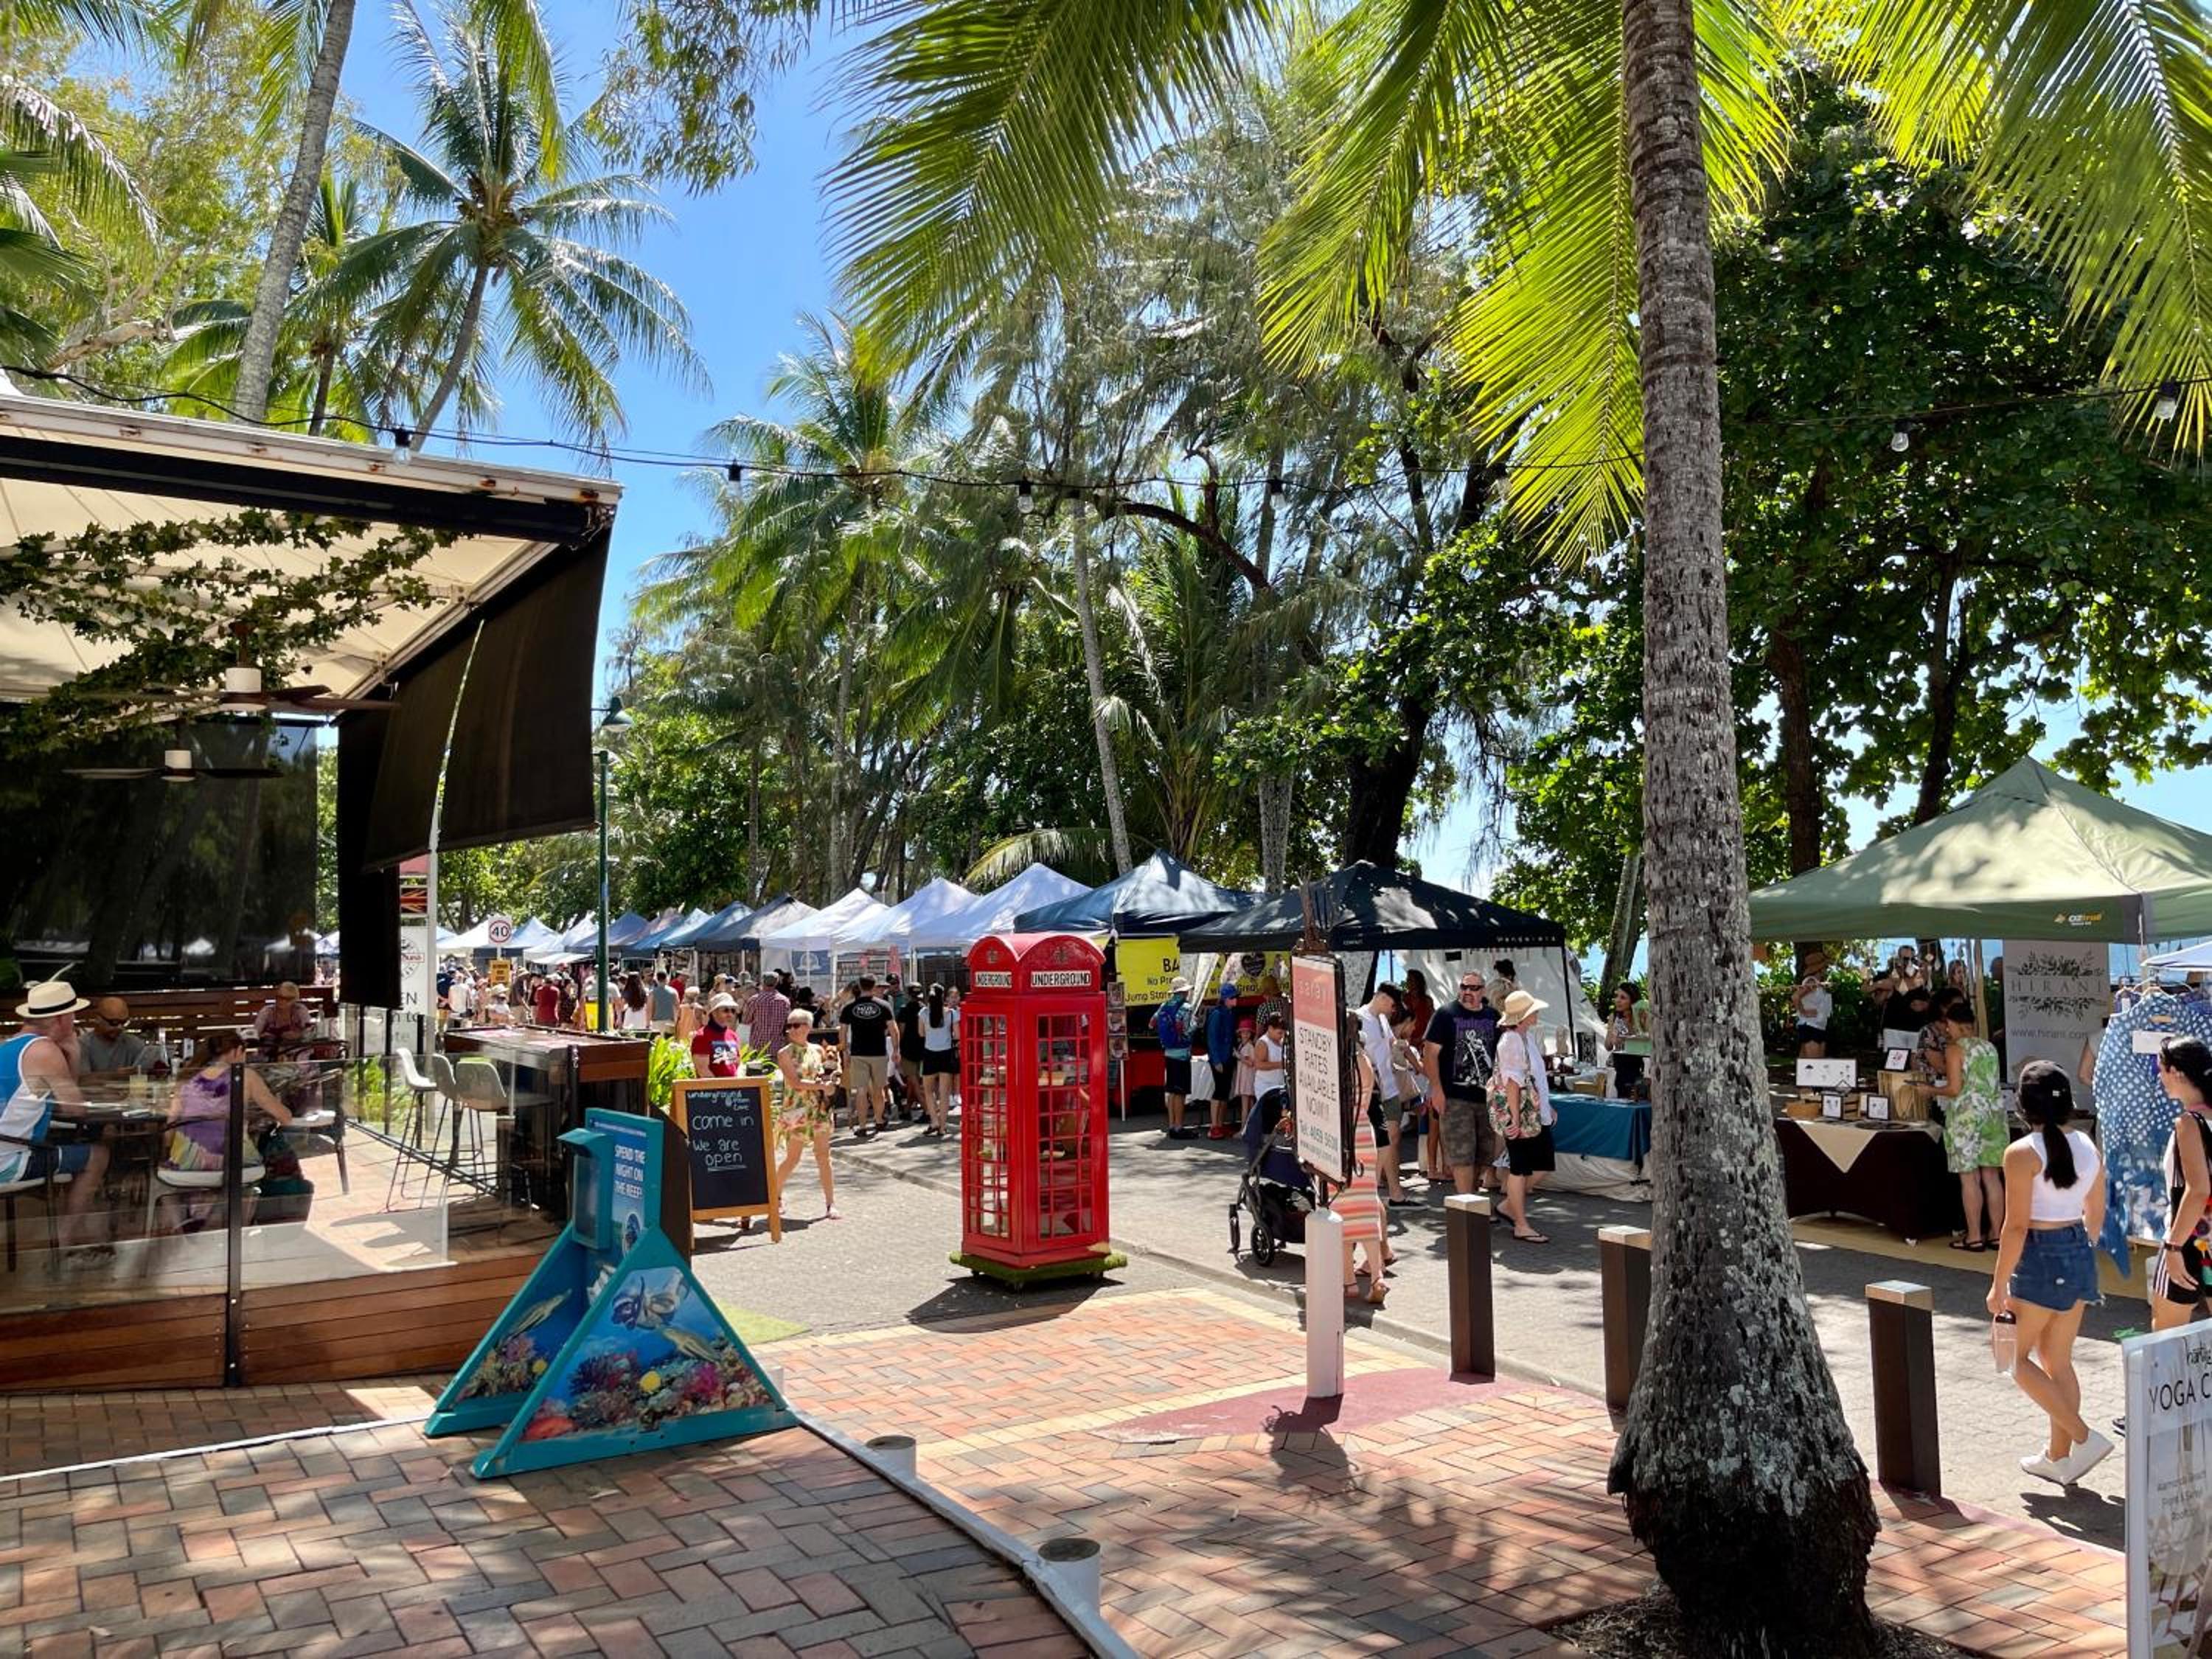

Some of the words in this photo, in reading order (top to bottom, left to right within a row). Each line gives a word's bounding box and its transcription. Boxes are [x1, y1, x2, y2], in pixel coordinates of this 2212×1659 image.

[492, 926, 509, 937] 40
[1032, 973, 1091, 987] UNDERGROUND
[2011, 979, 2101, 992] HIRANI
[1298, 1026, 1332, 1053] STANDBY
[1304, 1051, 1328, 1076] RATES
[1298, 1071, 1337, 1102] AVAILABLE
[740, 1116, 754, 1127] in
[717, 1138, 740, 1151] are
[615, 1144, 633, 1161] SPEND
[634, 1149, 646, 1165] THE
[705, 1152, 742, 1167] open
[615, 1163, 633, 1178] NIGHT
[633, 1167, 644, 1182] ON
[614, 1180, 626, 1194] THE
[2148, 1377, 2197, 1413] YOGA
